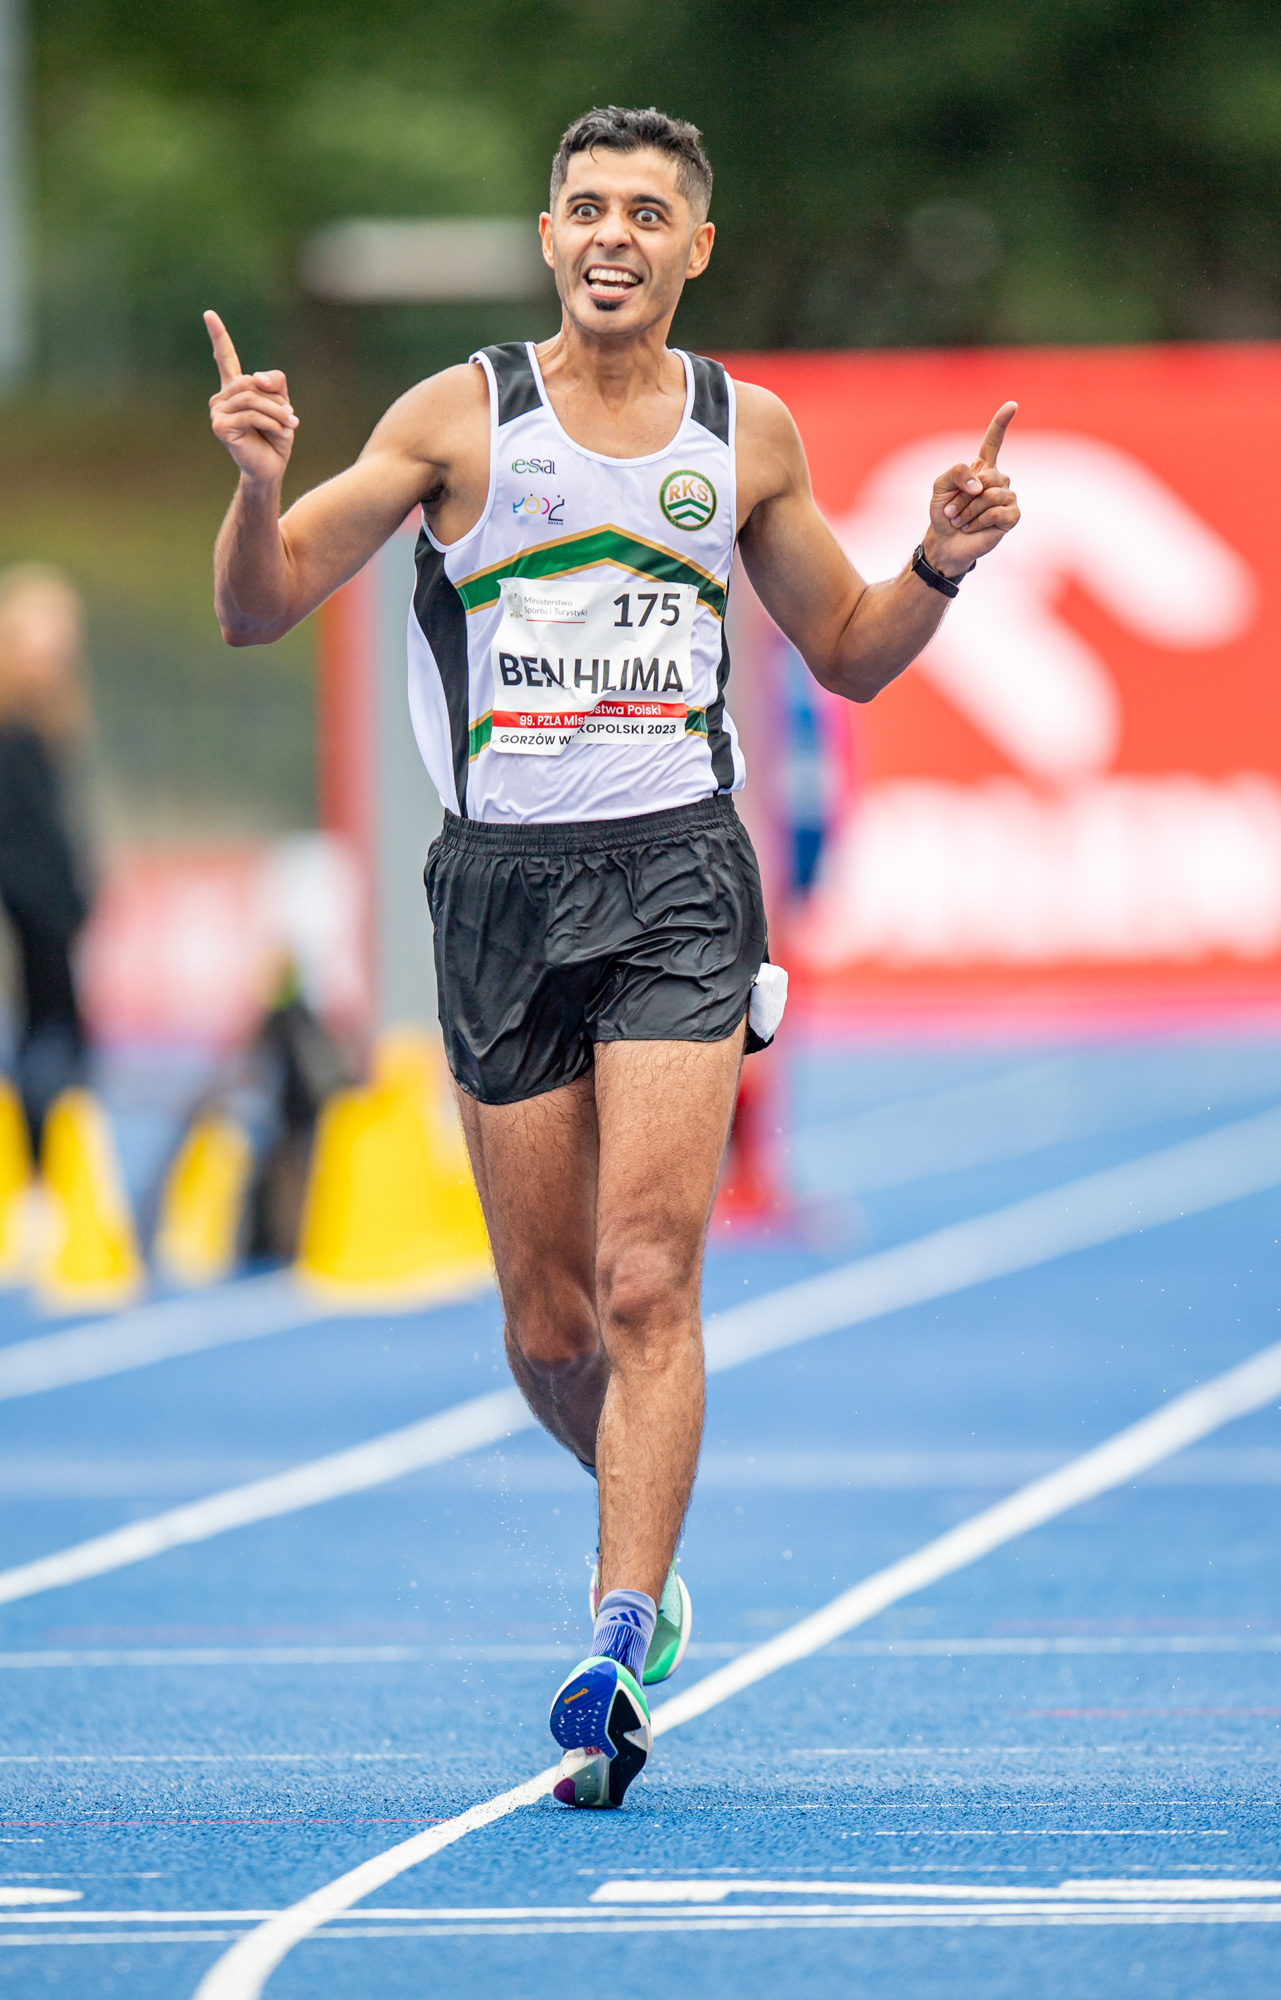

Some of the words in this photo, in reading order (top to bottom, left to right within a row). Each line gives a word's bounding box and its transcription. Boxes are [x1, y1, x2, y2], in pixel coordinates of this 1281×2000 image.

[669, 479, 709, 502] RKS
[524, 596, 573, 607] Ministerstwo
[524, 606, 548, 615] Sportu
[555, 609, 588, 617] Turystyki
[613, 593, 681, 628] 175
[499, 652, 565, 688] BEN
[574, 657, 683, 694] HLIMA
[520, 715, 535, 726] 99.
[538, 716, 562, 726] PZLA
[627, 704, 662, 715] Polski
[500, 733, 555, 745] GORZÓW
[647, 725, 676, 734] 2023
